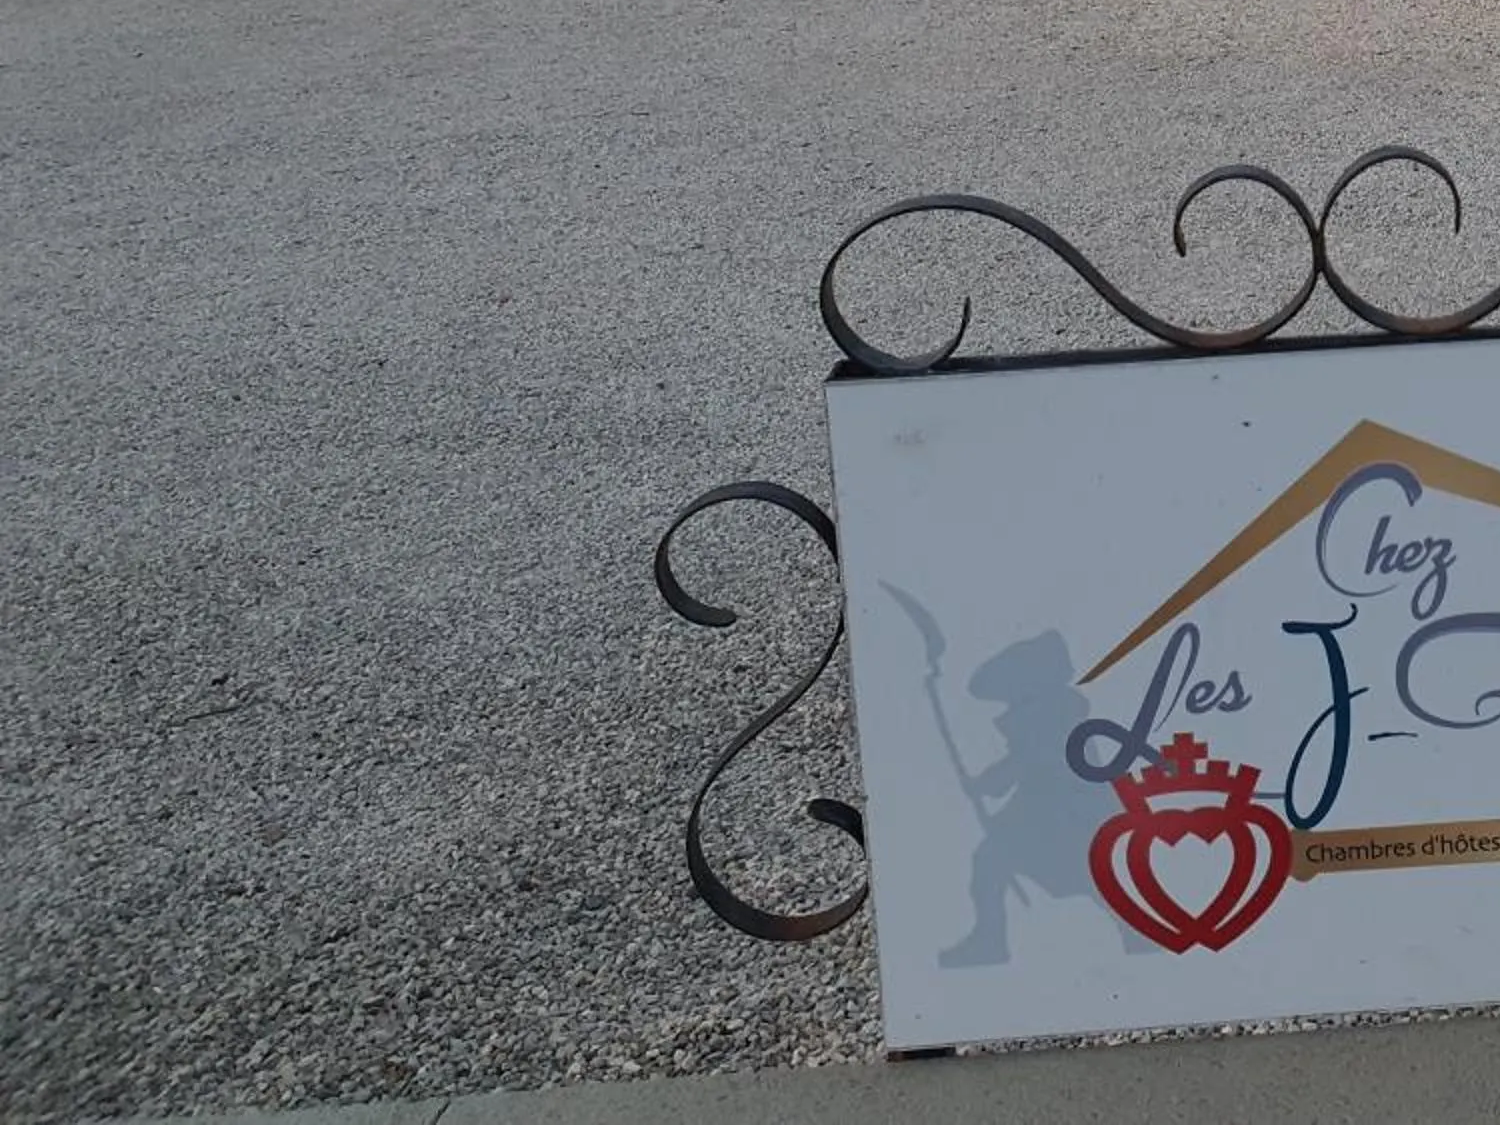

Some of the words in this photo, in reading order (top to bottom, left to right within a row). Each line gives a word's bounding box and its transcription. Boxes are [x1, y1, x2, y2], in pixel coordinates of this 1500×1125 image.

[1315, 462, 1458, 620] Chez
[1065, 621, 1253, 783] Les
[1305, 839, 1415, 863] Chambres
[1421, 834, 1500, 855] d'hôtes
